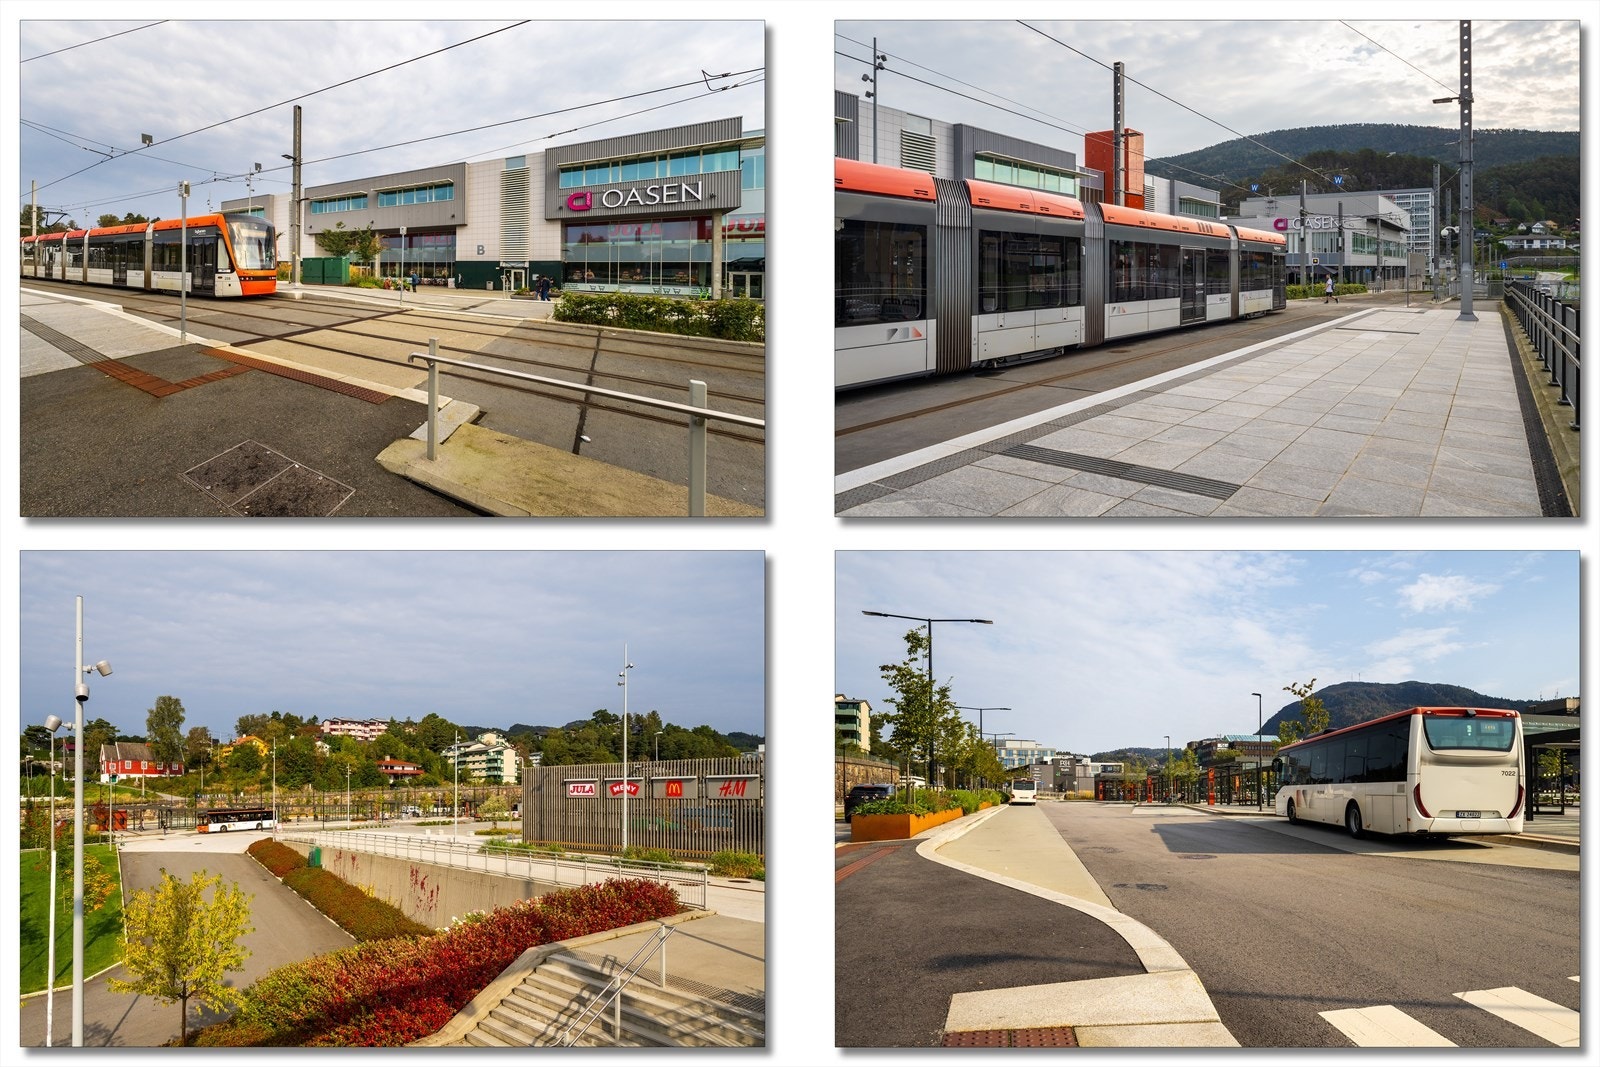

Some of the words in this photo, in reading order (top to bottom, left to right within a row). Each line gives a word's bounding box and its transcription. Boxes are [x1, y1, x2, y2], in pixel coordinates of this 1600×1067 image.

[602, 180, 702, 208] OASEN
[477, 245, 485, 255] B
[569, 785, 595, 794] JULA
[613, 784, 636, 793] MENY
[719, 780, 748, 797] H&M
